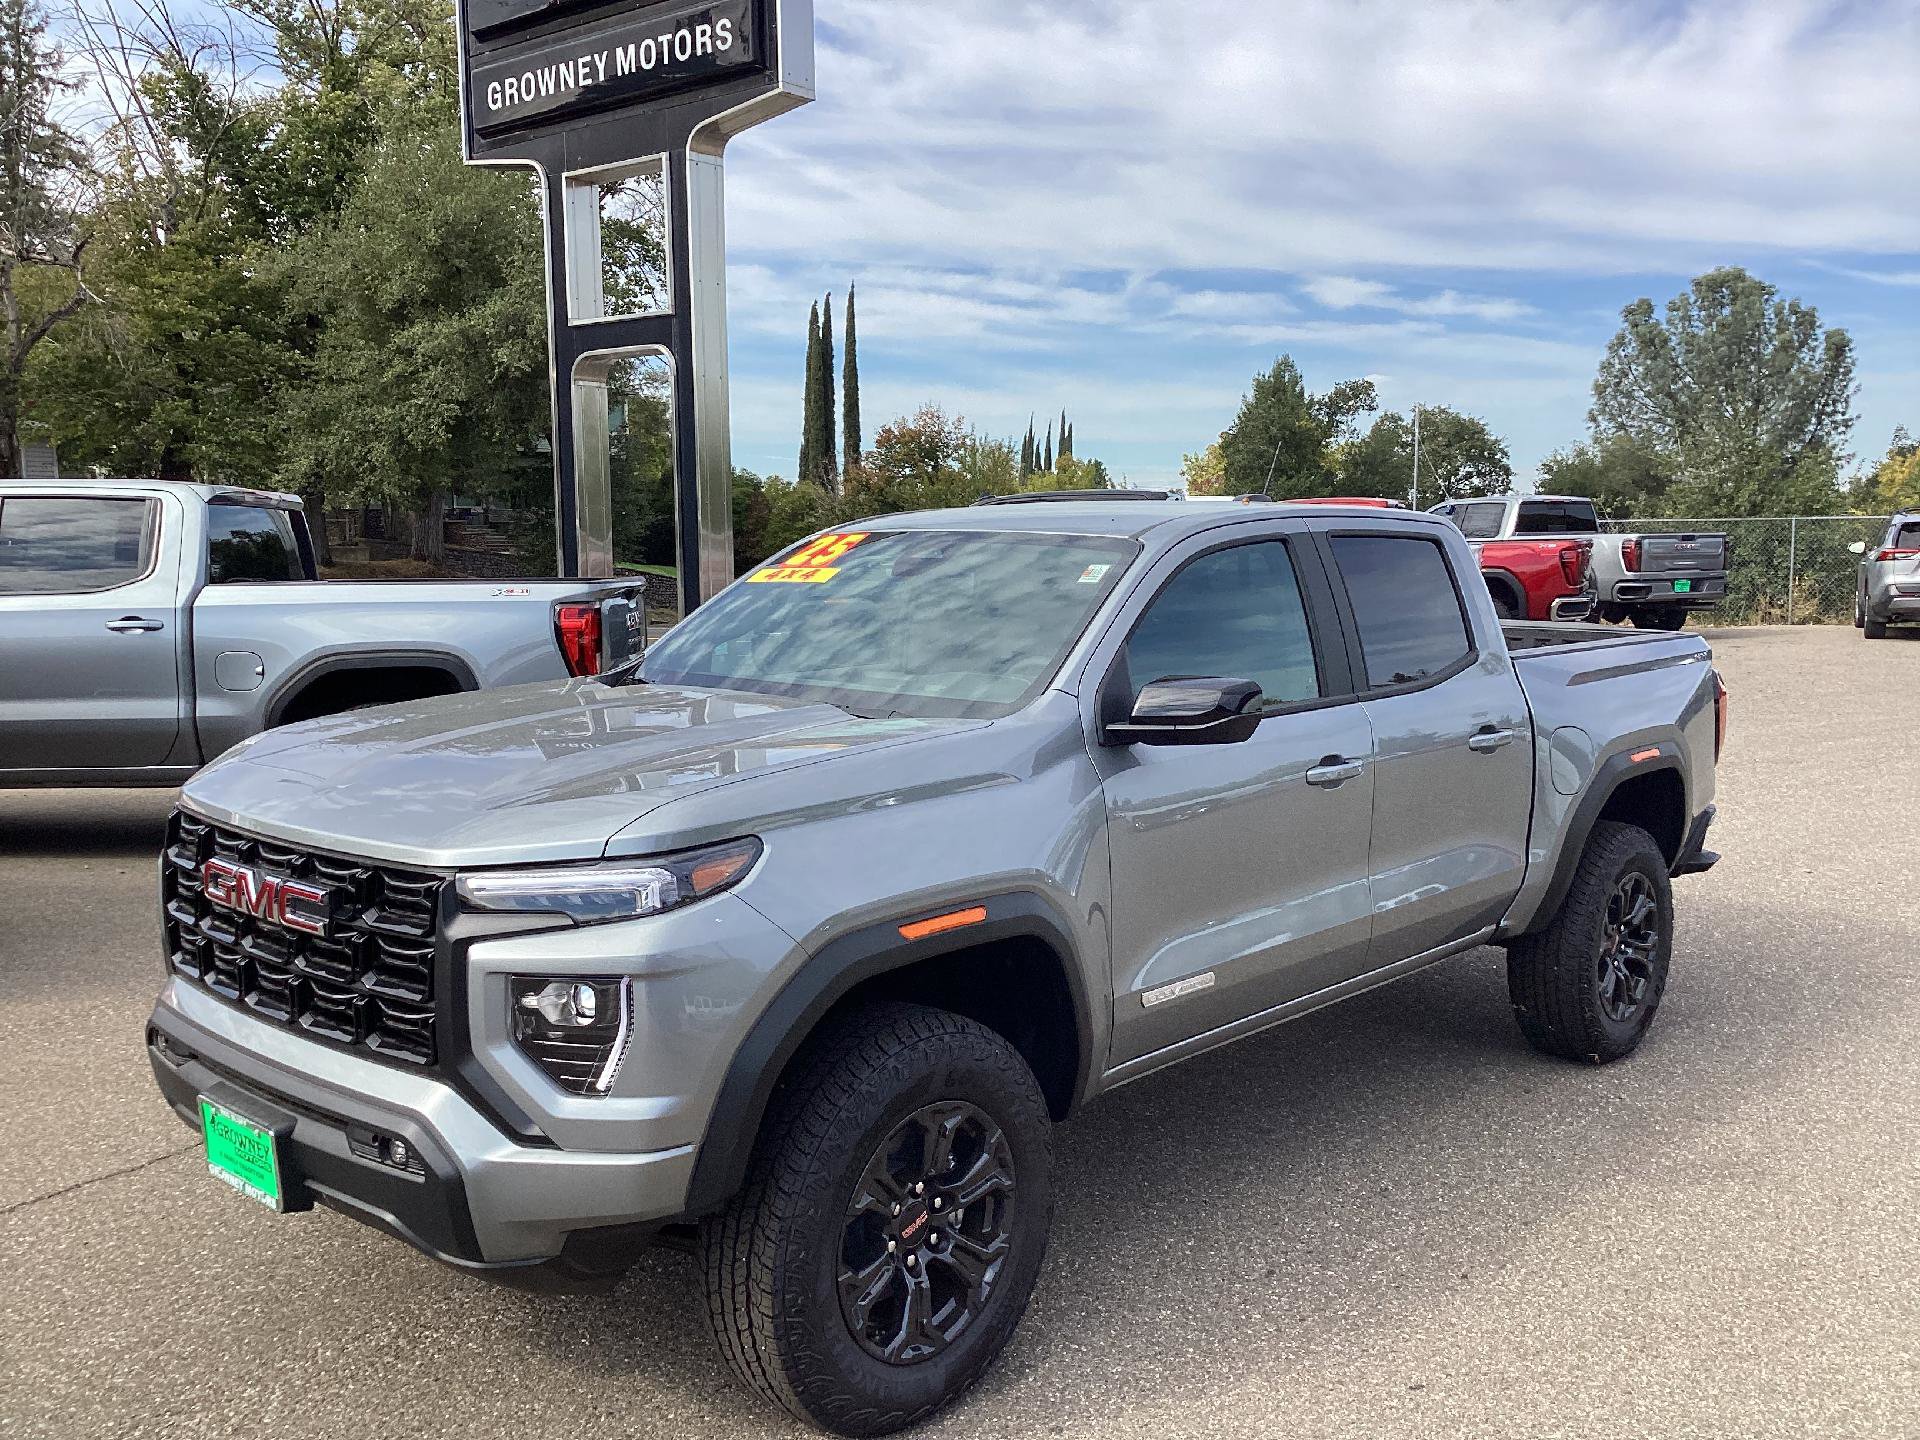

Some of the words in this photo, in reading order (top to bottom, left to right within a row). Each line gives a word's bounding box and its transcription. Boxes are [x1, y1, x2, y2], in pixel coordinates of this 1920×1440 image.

[487, 51, 609, 112] GROWNEY
[615, 17, 734, 77] MOTORS
[782, 532, 867, 566] 25
[204, 856, 330, 937] GMC
[215, 1121, 270, 1159] GROWNEY
[901, 1209, 929, 1239] GMC
